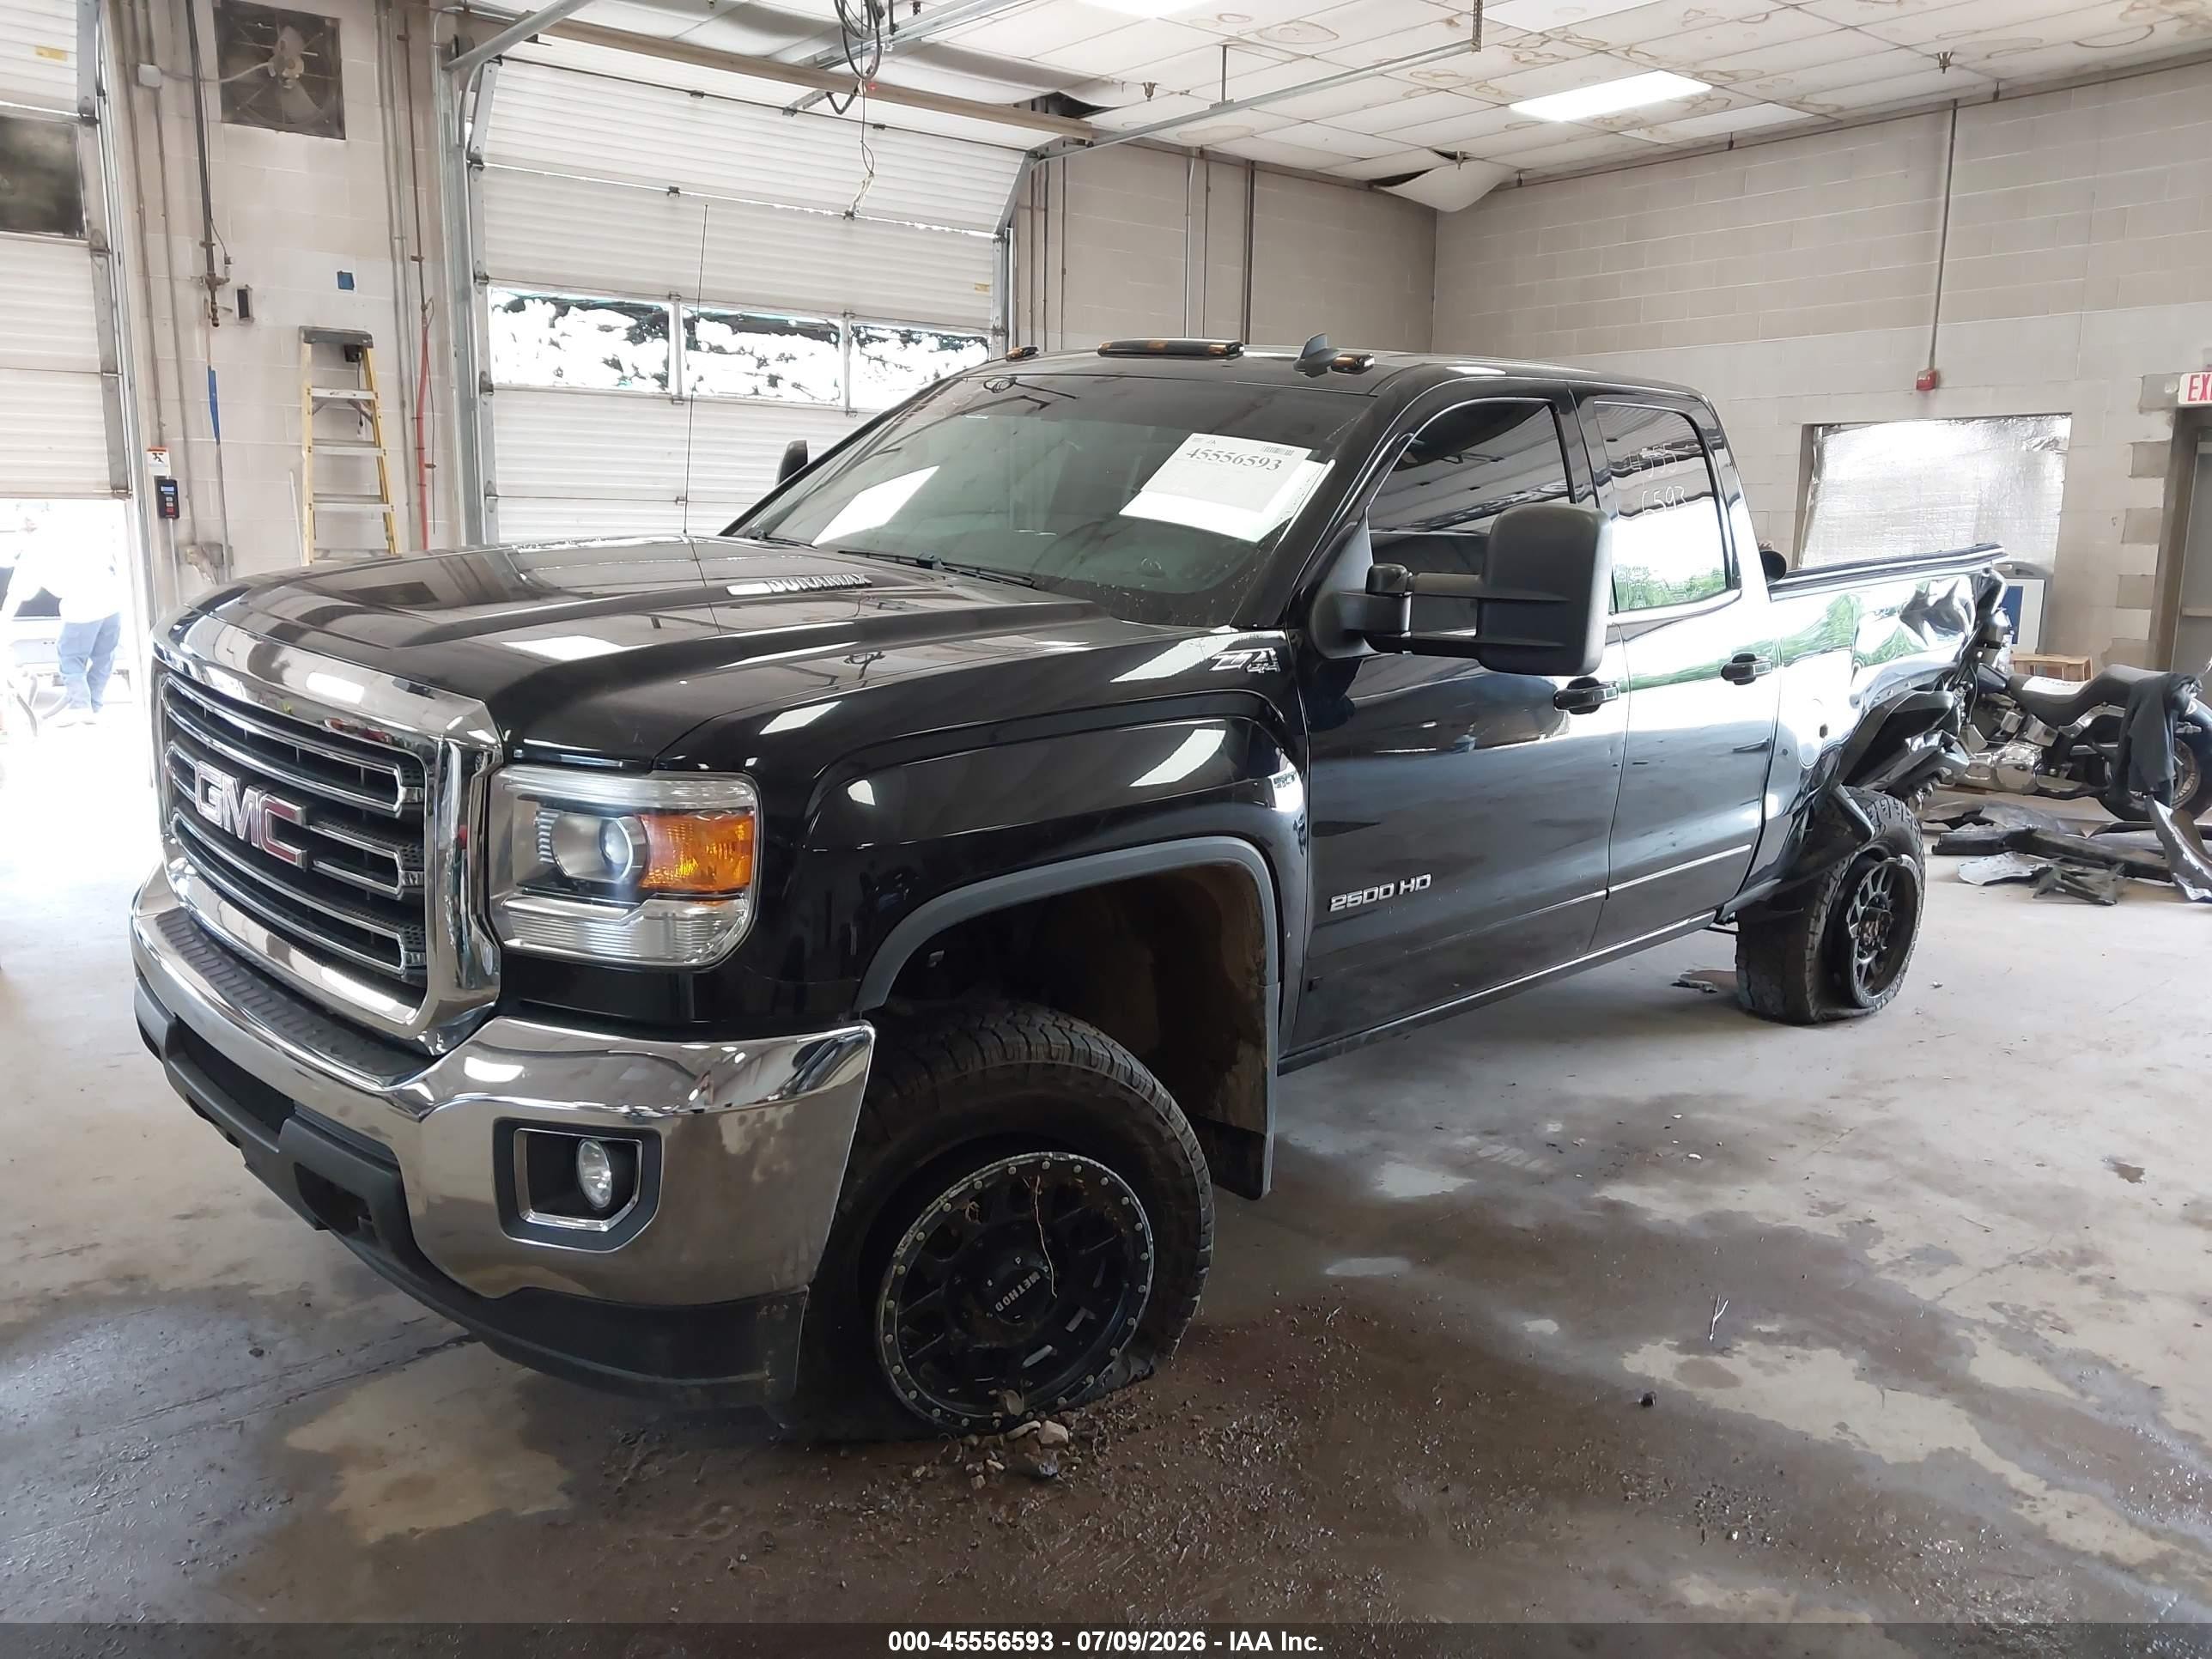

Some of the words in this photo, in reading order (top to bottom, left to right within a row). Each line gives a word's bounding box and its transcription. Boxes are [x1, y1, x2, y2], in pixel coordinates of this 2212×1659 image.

[1186, 447, 1284, 471] 45556593
[1641, 485, 1688, 516] 6593
[767, 573, 873, 593] DURAMAX
[195, 760, 307, 872] GMC
[1329, 882, 1395, 913] 2500
[1399, 873, 1432, 896] HD
[994, 1270, 1042, 1312] METHOD
